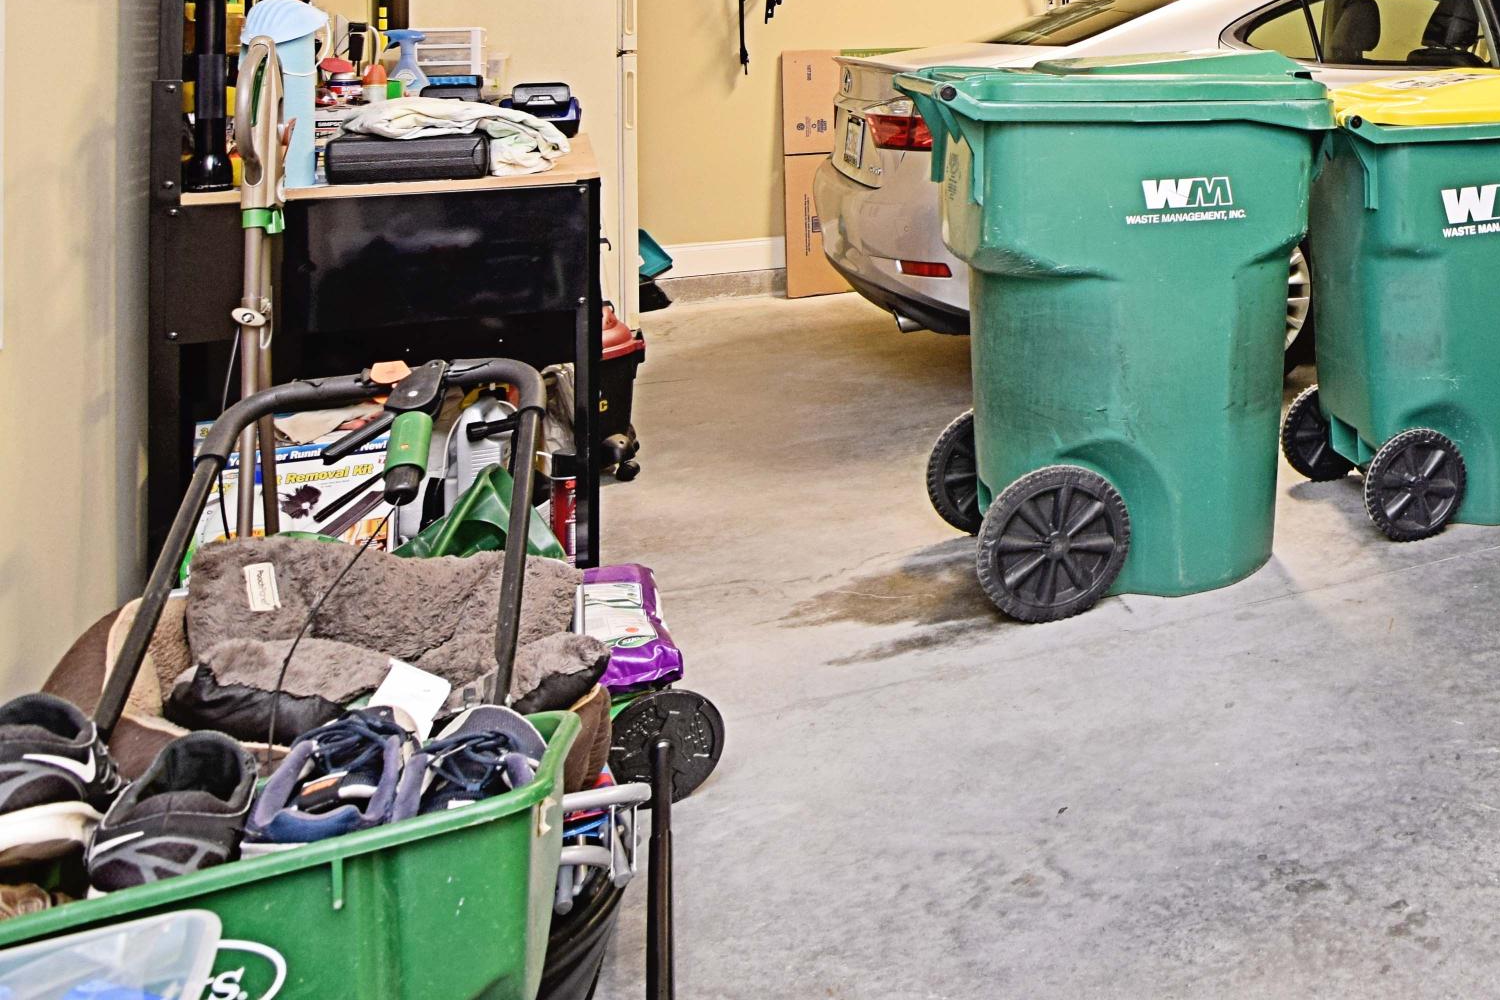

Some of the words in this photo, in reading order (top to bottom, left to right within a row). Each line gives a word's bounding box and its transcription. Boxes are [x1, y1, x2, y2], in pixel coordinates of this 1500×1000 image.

[1142, 176, 1234, 210] WM
[1125, 214, 1160, 225] WASTE
[1161, 210, 1228, 223] MANAGEMENT,
[1229, 209, 1247, 219] INC.
[1442, 226, 1477, 238] WASTE
[286, 467, 349, 484] Removal
[352, 463, 375, 477] Kit
